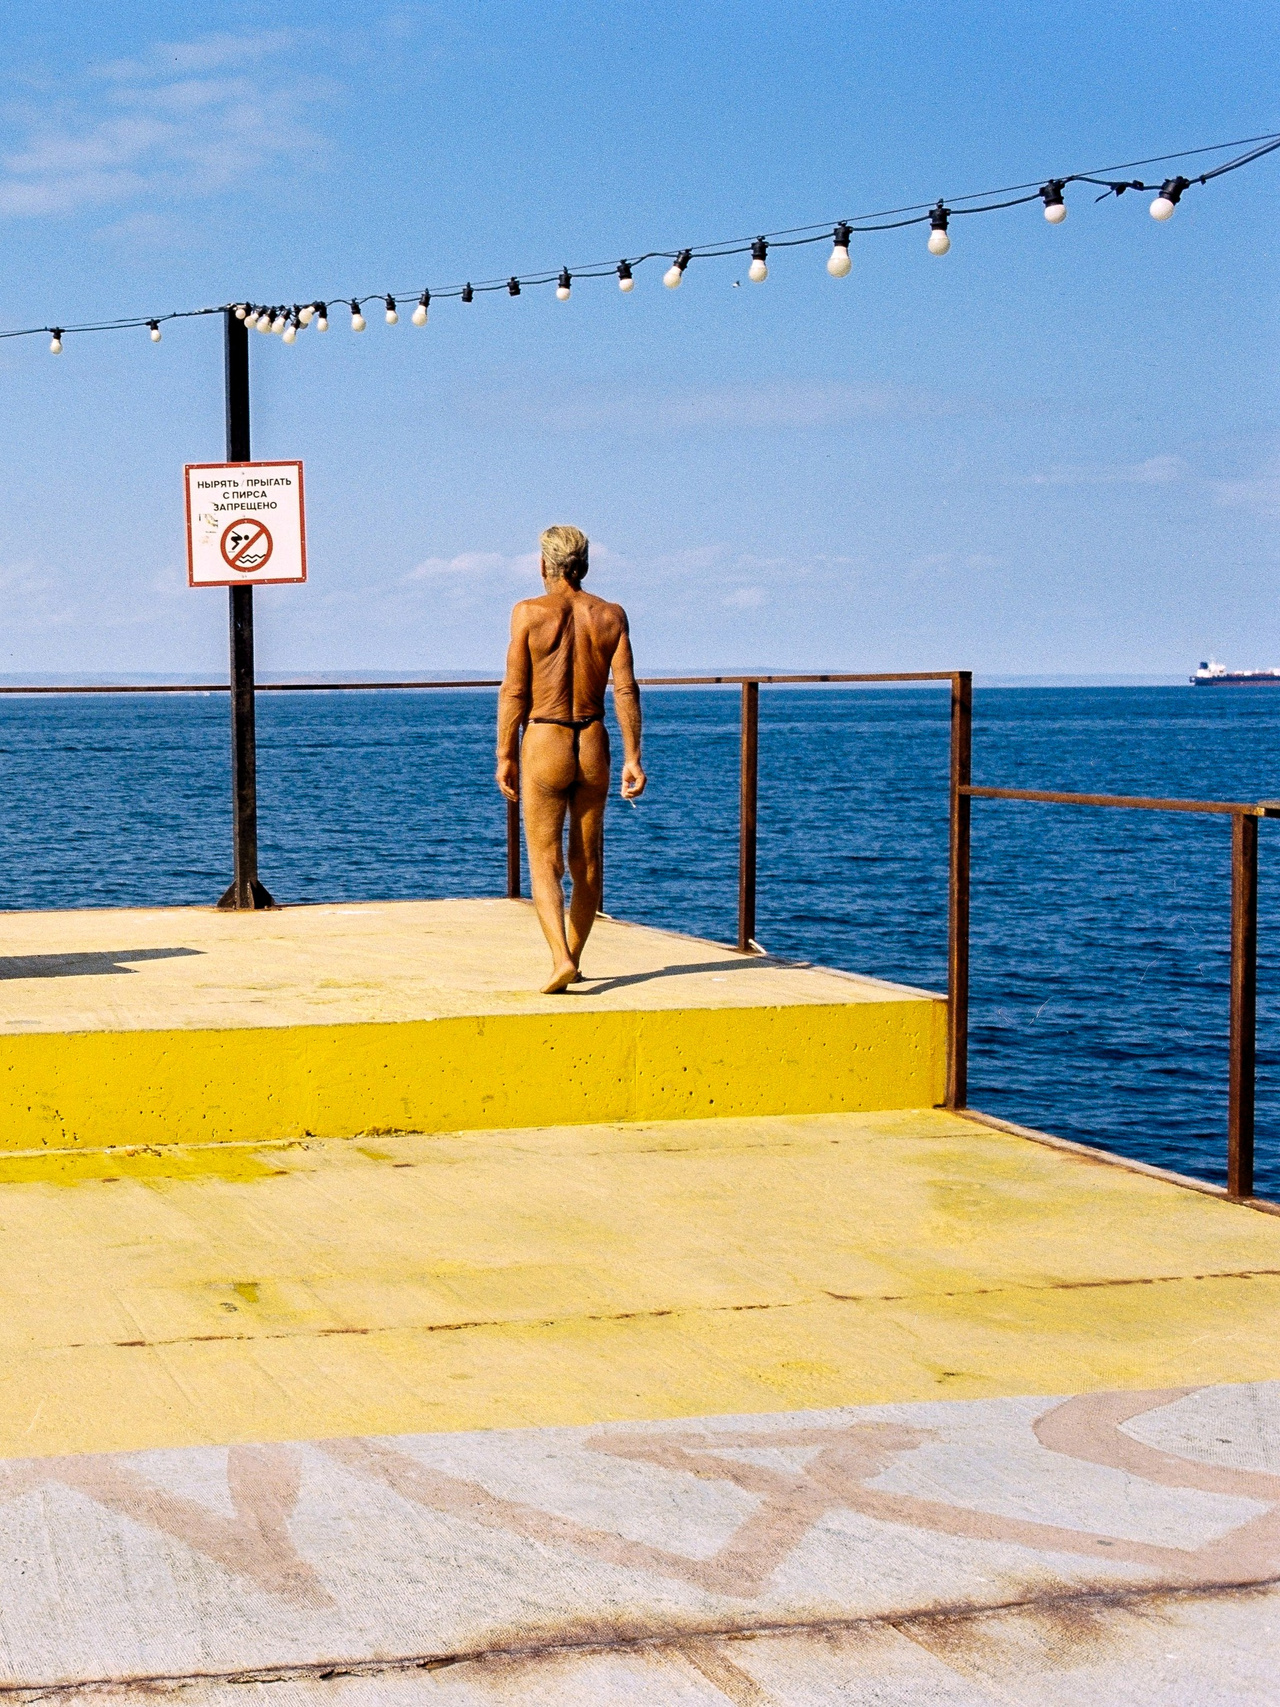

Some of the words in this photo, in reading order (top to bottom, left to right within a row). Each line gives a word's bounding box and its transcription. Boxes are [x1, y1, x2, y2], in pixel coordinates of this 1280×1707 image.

[197, 480, 239, 489] НЫРЯТЬ
[246, 478, 292, 487] ПРЫГАТЬ
[222, 491, 230, 500] С
[232, 490, 268, 499] ПИРСА
[213, 501, 278, 511] ЗАПРЕЩЕНО
